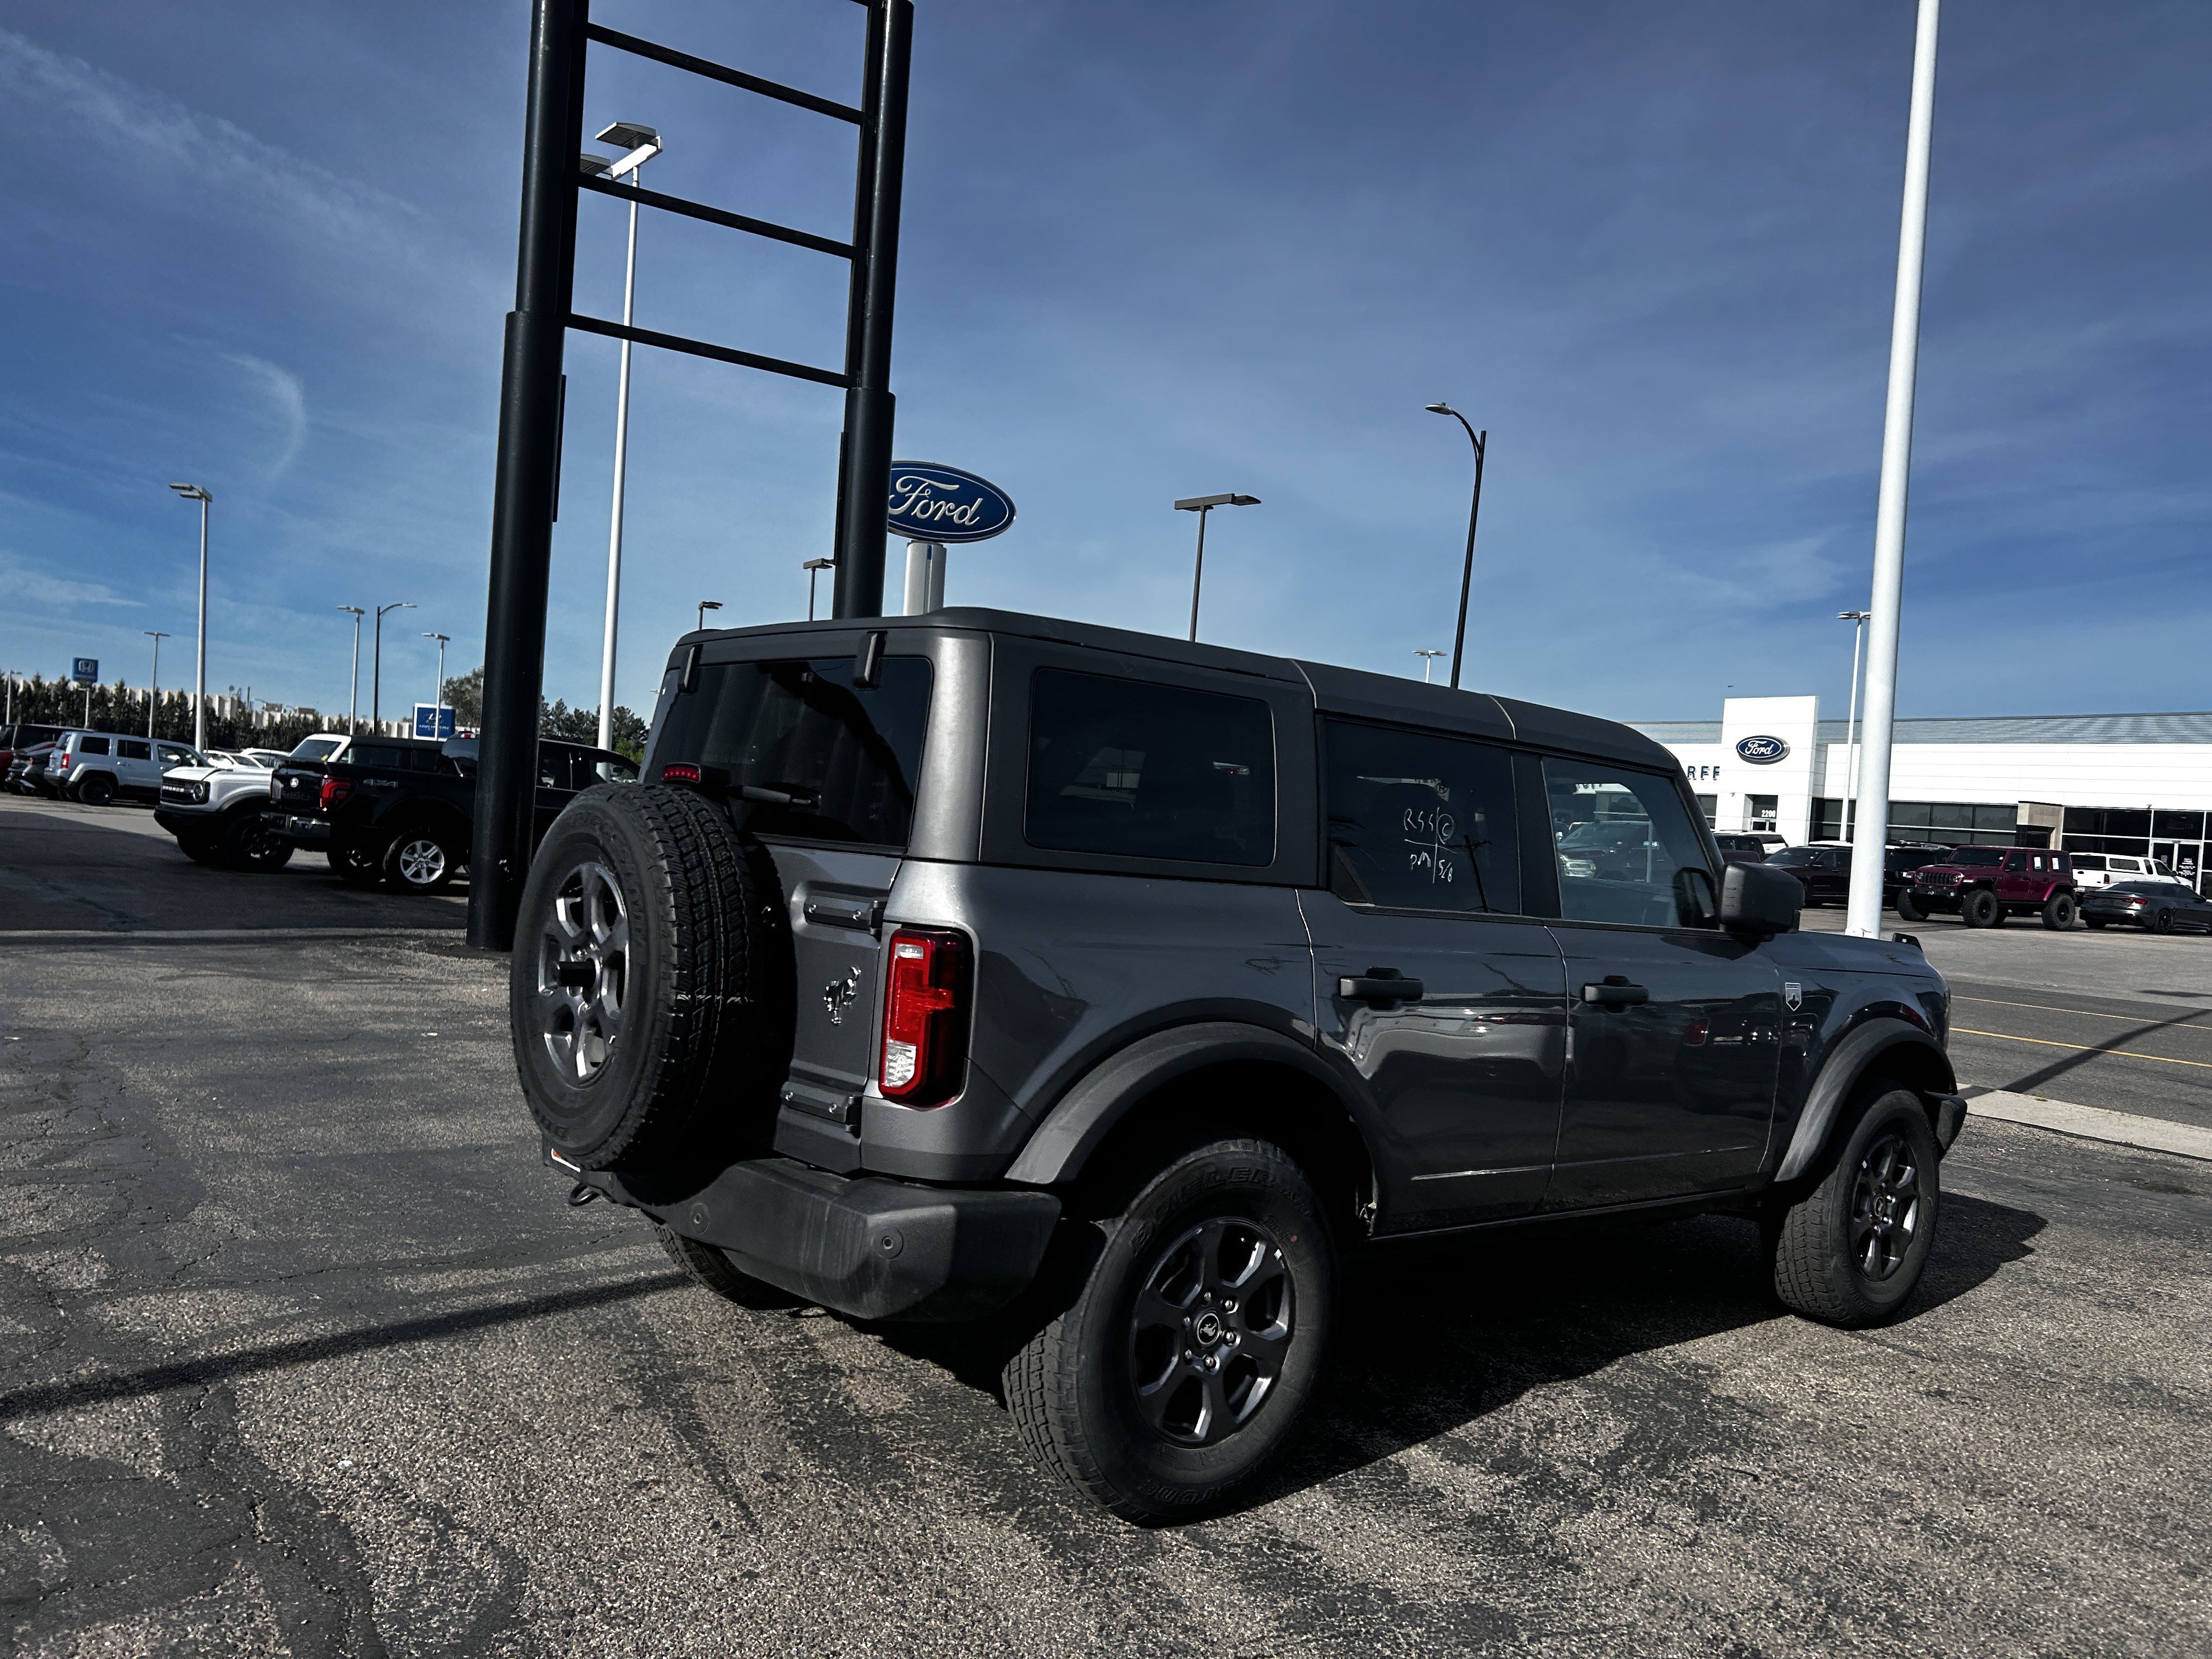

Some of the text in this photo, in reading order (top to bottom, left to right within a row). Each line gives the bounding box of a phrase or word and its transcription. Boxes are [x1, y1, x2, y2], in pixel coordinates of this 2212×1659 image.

[889, 476, 984, 527] Ford
[1745, 740, 1774, 755] Ford
[1687, 766, 1720, 780] RFF
[1761, 809, 1776, 818] 2200
